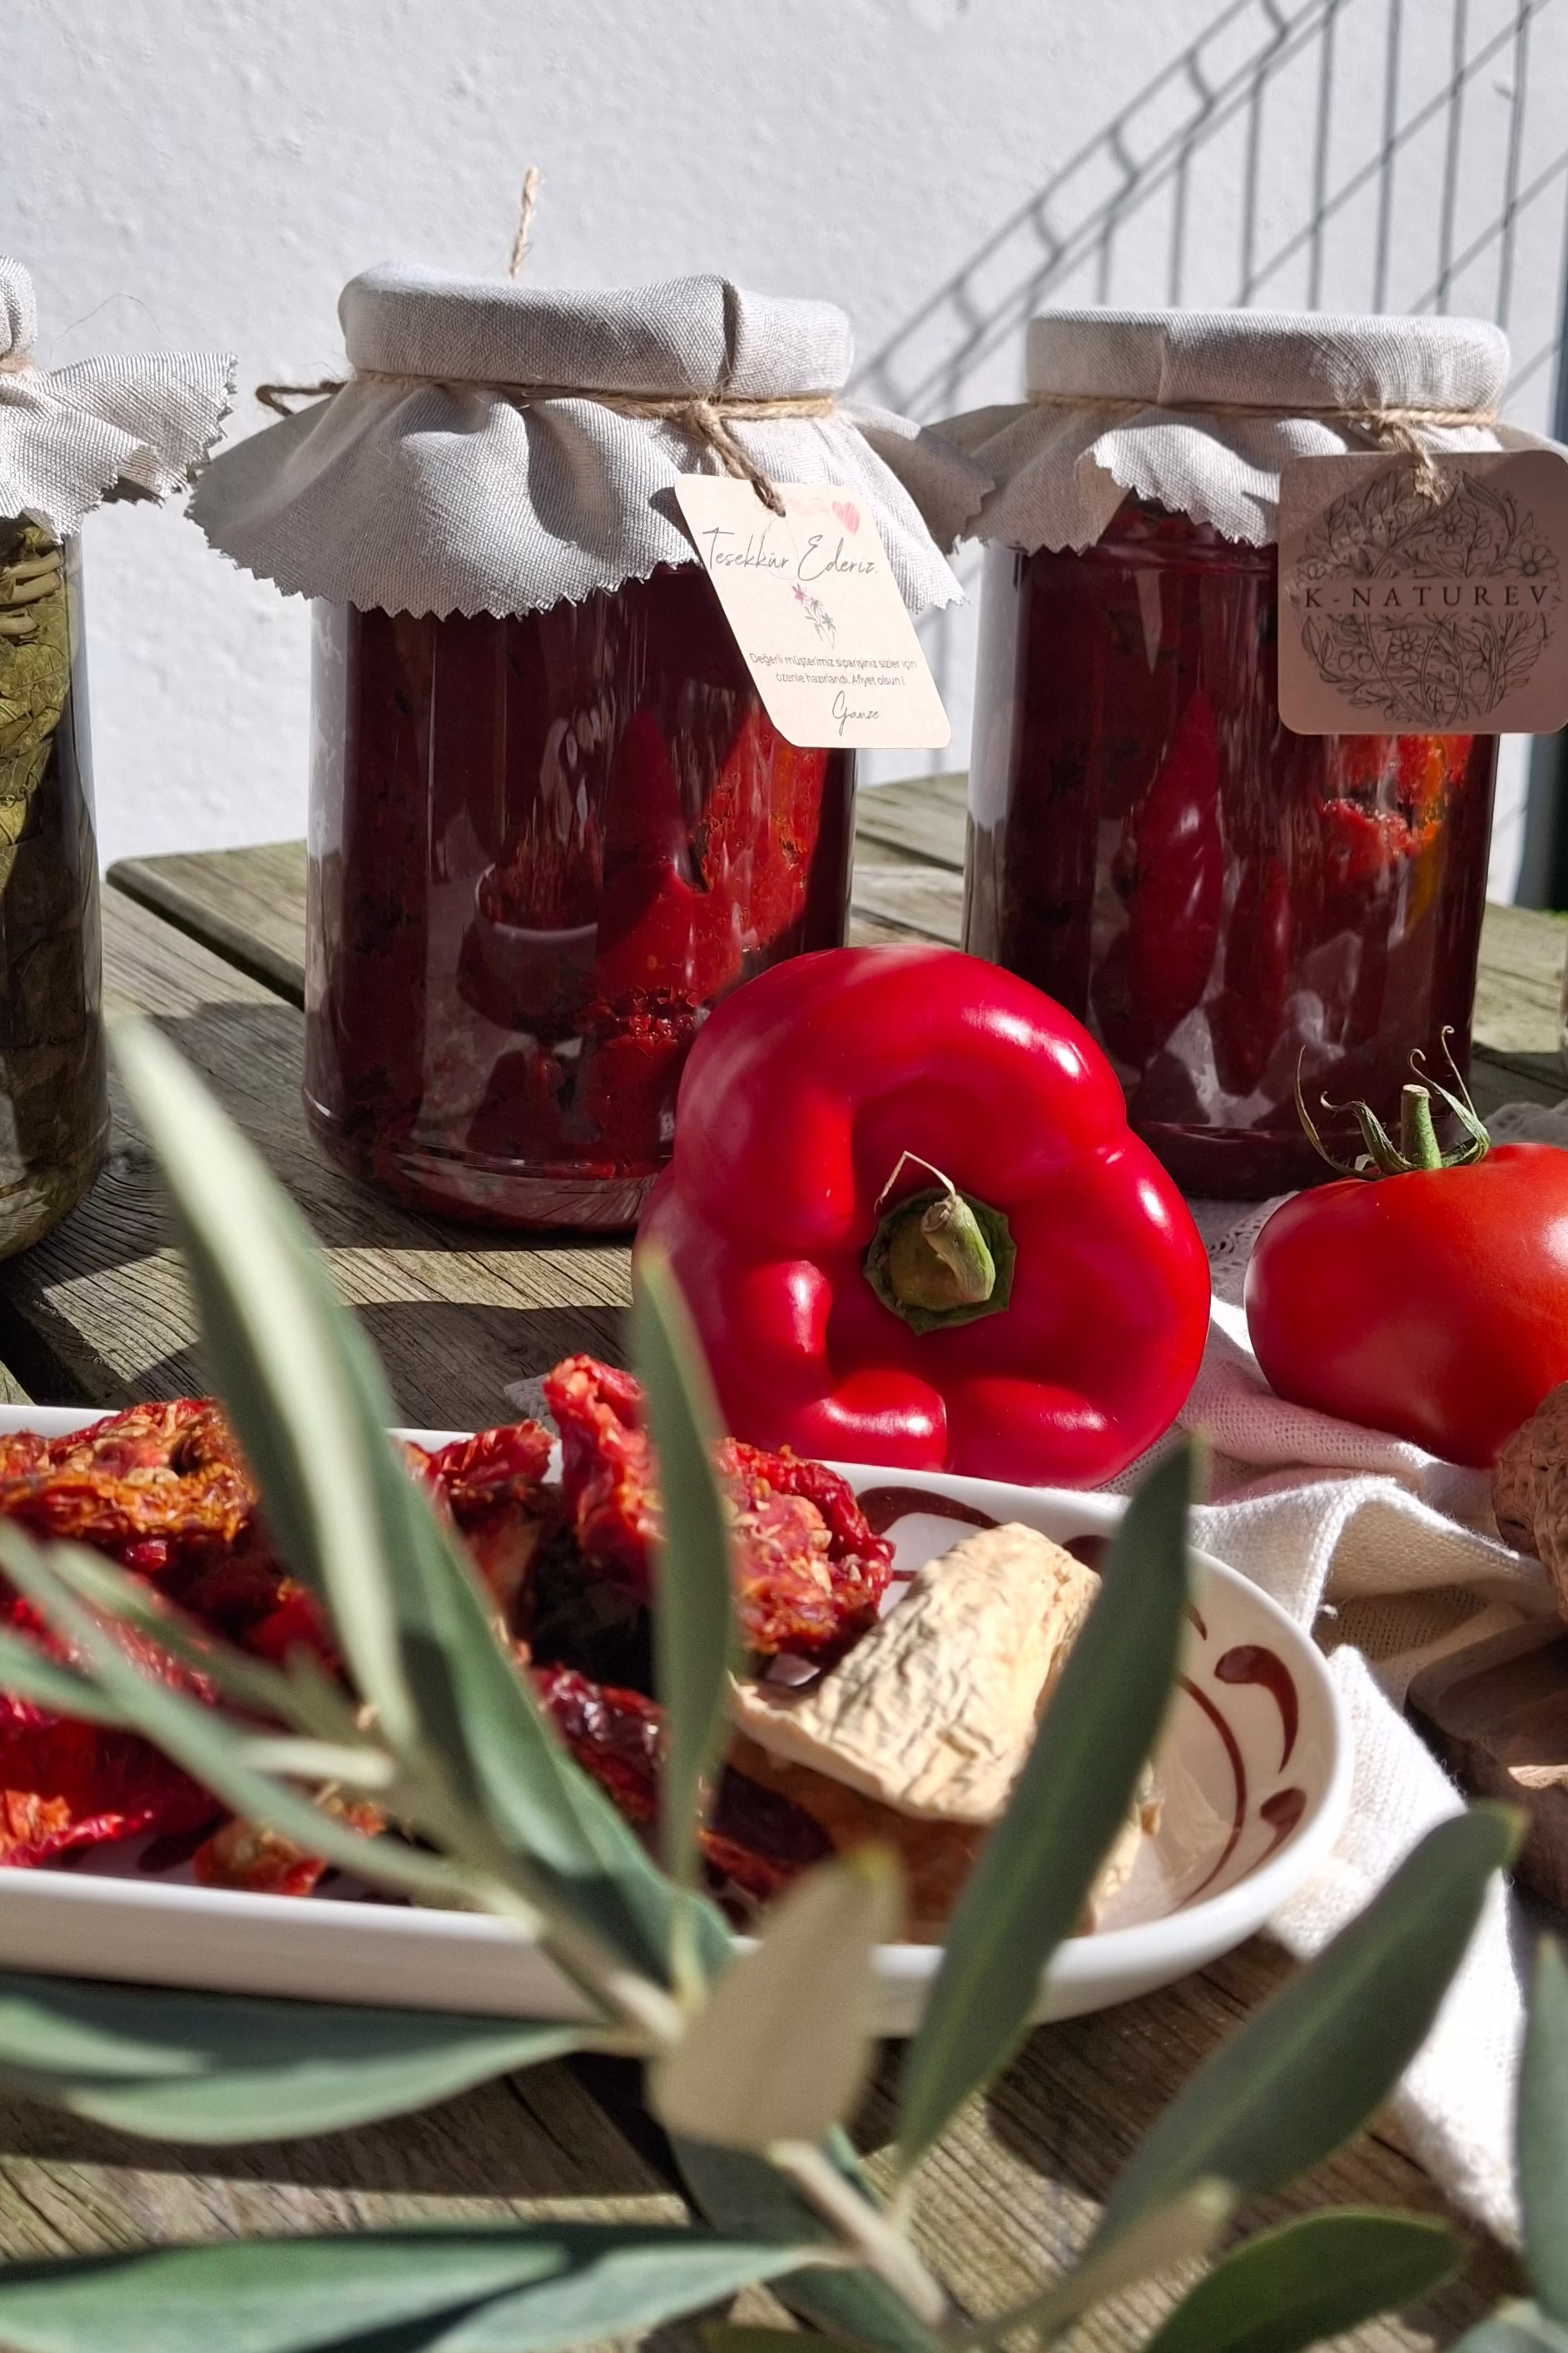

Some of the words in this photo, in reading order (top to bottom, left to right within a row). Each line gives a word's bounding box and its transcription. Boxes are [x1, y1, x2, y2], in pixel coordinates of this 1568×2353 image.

[749, 653, 783, 667] Değerli
[775, 671, 805, 683] özenle
[852, 673, 876, 687] Afiyet
